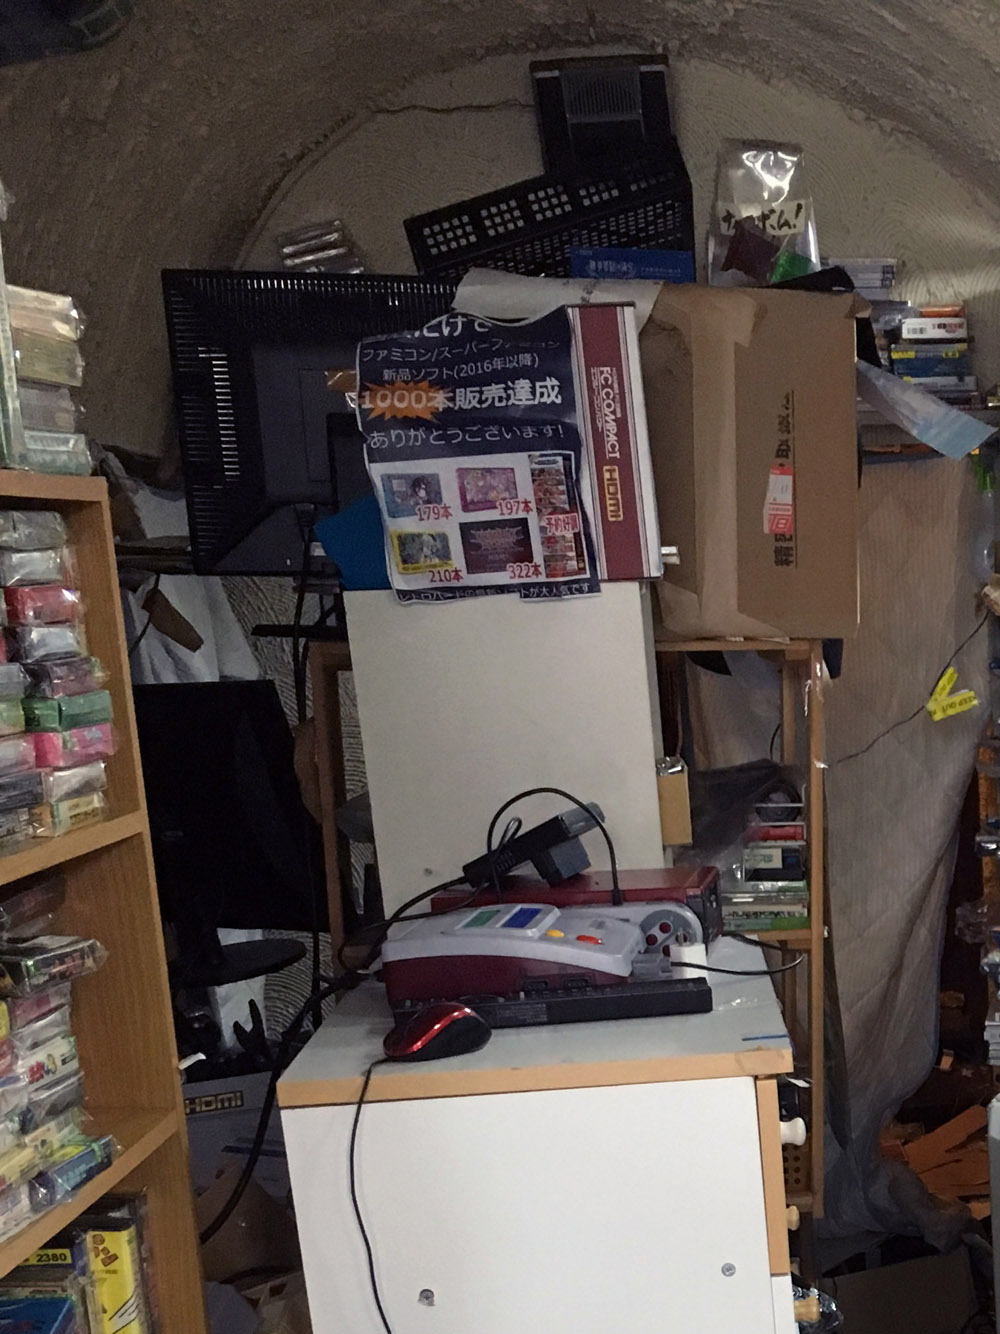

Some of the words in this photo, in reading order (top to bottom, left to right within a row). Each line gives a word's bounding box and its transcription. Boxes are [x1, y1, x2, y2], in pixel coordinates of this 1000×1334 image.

[382, 352, 540, 381] 新品ソフト(2016年以降)
[361, 376, 562, 411] 1000本販売達成
[601, 387, 620, 460] COMPACT
[369, 425, 563, 449] ありがとうございます!
[605, 467, 622, 521] HDMI
[416, 504, 453, 521] 179本
[497, 499, 534, 516] 197本
[429, 567, 464, 583] 210本
[508, 562, 542, 579] 322本
[36, 1252, 67, 1264] 2380
